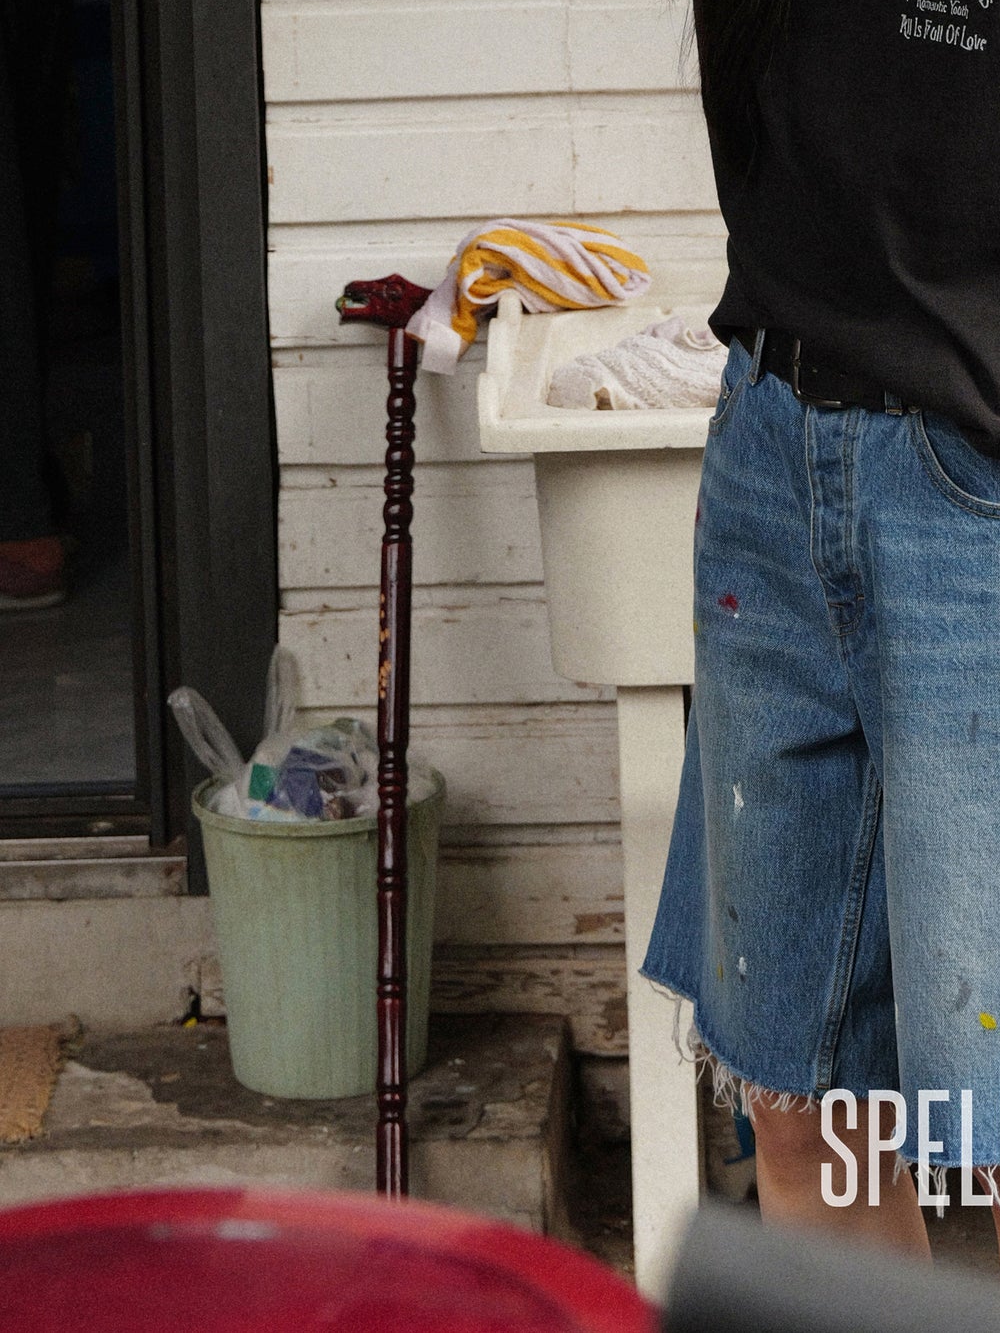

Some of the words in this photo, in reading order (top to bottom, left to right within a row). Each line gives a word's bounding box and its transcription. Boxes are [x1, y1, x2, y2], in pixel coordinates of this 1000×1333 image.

[950, 0, 969, 19] Youth
[900, 13, 913, 40] All
[913, 17, 922, 38] Is
[923, 19, 944, 42] Full
[946, 24, 961, 46] Of
[960, 25, 987, 51] Love
